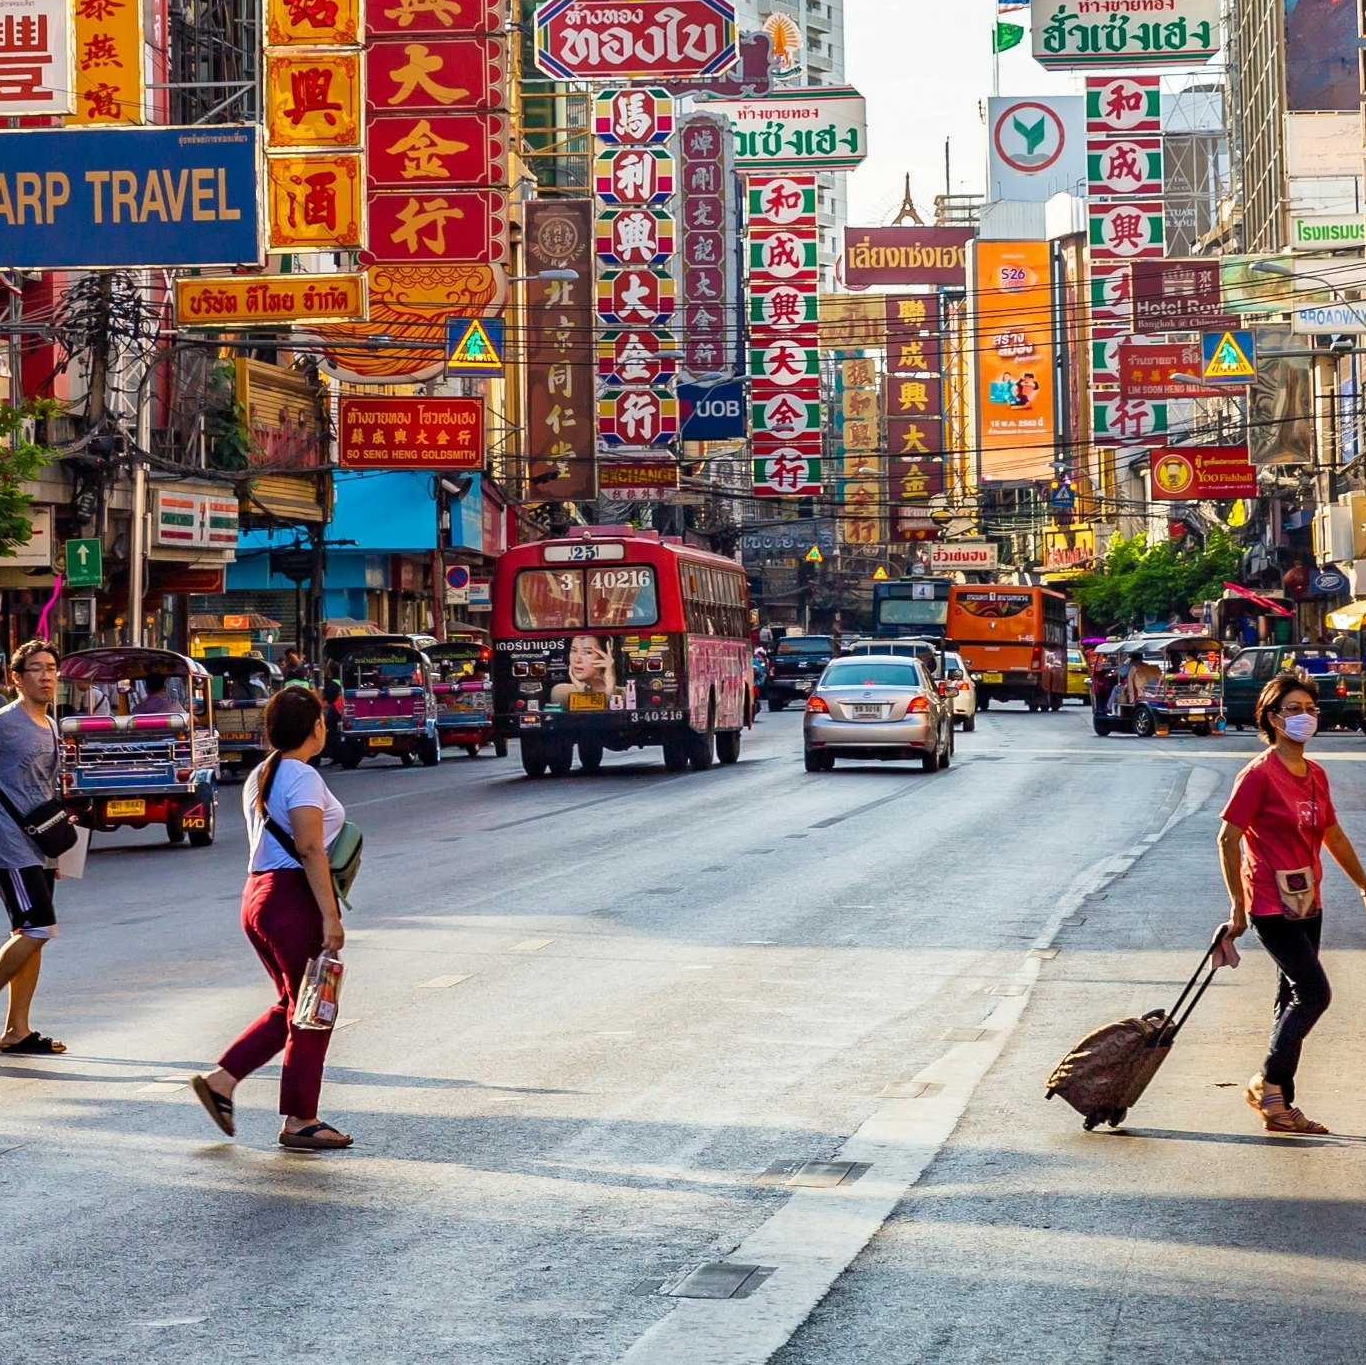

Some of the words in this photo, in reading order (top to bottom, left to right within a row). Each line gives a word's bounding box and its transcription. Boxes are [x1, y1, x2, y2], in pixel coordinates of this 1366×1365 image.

[565, 3, 644, 25] ห้างทอง
[559, 7, 718, 65] ทองใบ
[737, 105, 820, 120] ห้างขายทอง
[86, 168, 240, 224] TRAVEL
[616, 94, 657, 439] 馬利興大金行
[1106, 85, 1149, 436] 和成興行
[1137, 299, 1181, 315] Hotel
[1138, 319, 1175, 329] Bangkok
[766, 184, 804, 489] 和成興大金行
[347, 407, 412, 425] ห้างขายทอง
[696, 400, 740, 417] UOB
[347, 450, 360, 459] SO
[363, 450, 388, 459] SENG
[392, 450, 417, 459] HENG
[421, 450, 476, 460] GOLDSMITH
[1220, 473, 1253, 482] Fishball
[590, 570, 651, 589] 40216
[631, 710, 683, 723] 3-40216
